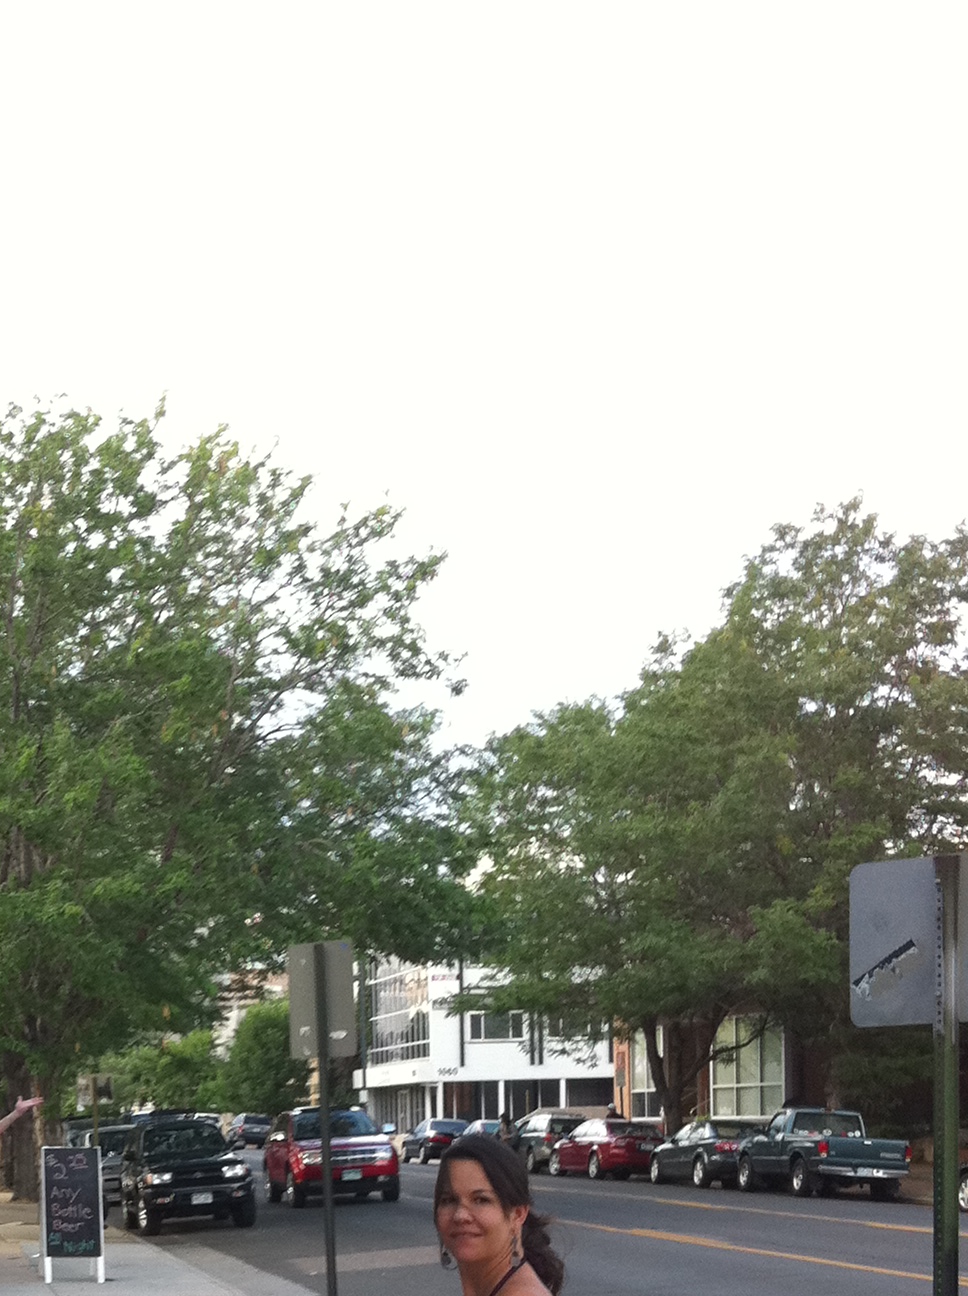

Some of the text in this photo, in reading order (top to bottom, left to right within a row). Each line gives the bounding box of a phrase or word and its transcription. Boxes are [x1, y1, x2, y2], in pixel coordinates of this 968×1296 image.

[50, 1186, 81, 1203] Any
[51, 1203, 94, 1219] Bottle
[52, 1219, 84, 1232] Beer
